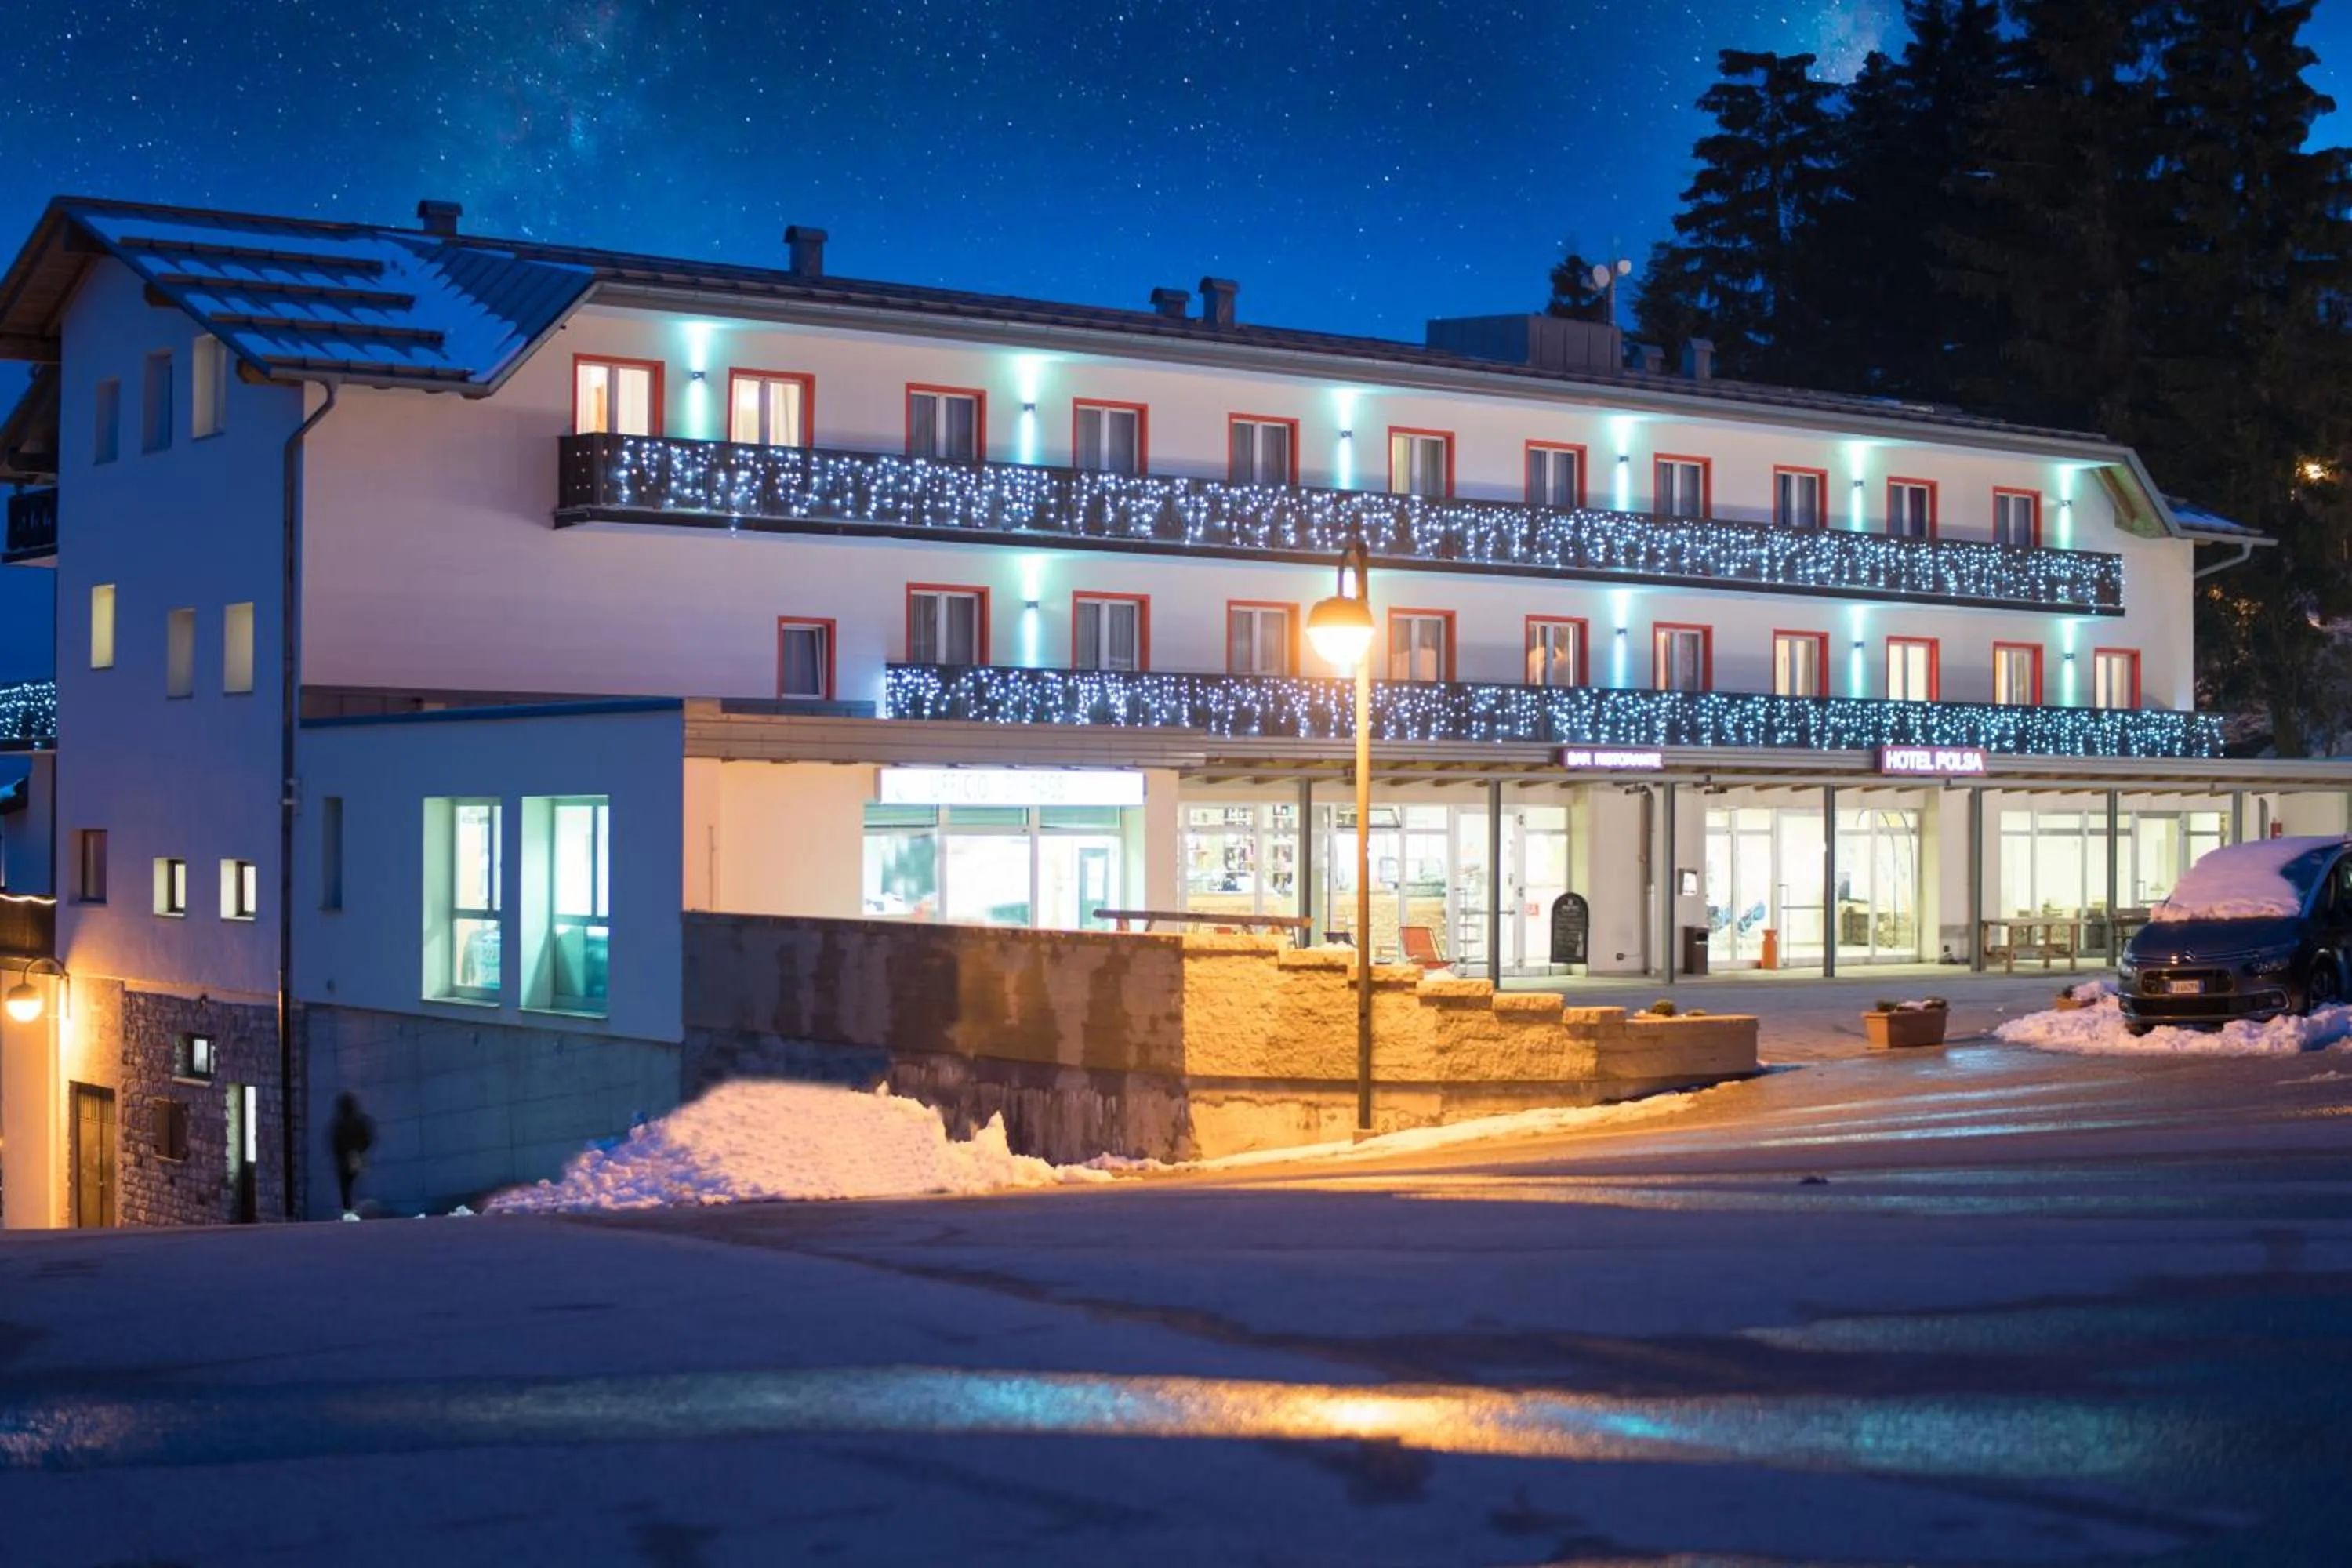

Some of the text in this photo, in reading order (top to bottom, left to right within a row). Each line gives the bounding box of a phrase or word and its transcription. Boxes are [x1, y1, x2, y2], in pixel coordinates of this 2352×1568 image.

[1567, 751, 1592, 766] BAR
[1886, 750, 1983, 771] HOTEL POLSA
